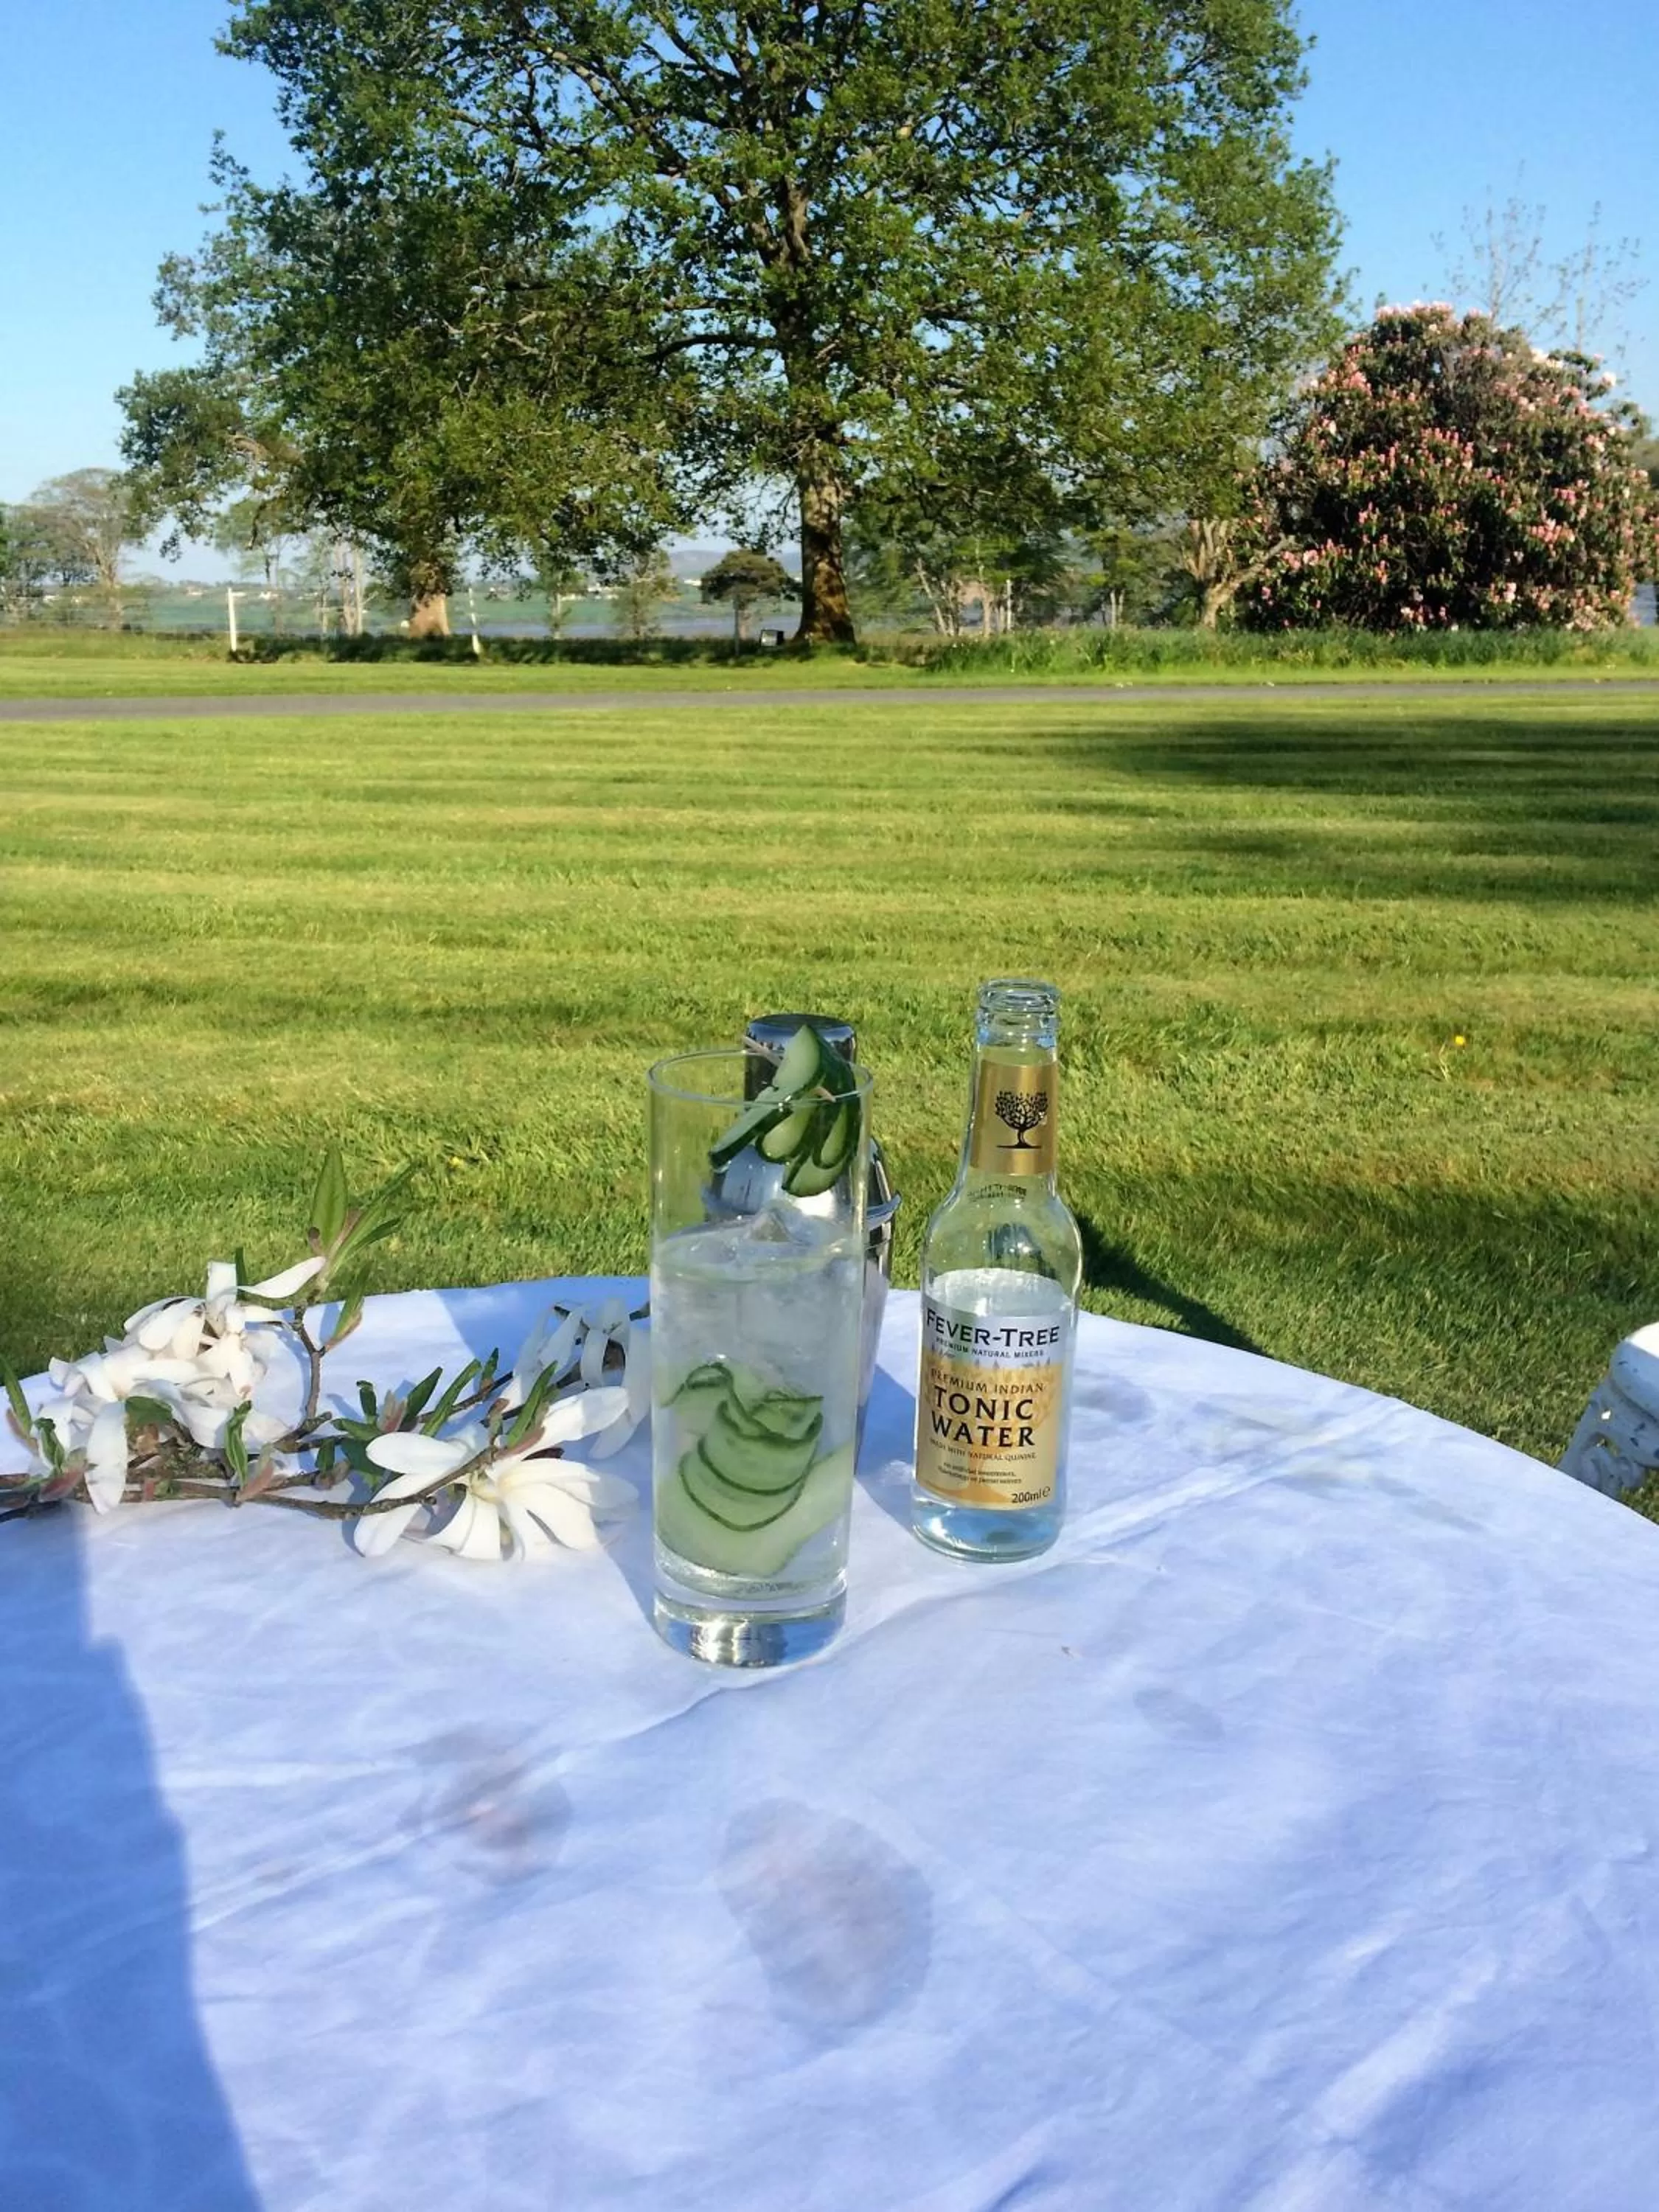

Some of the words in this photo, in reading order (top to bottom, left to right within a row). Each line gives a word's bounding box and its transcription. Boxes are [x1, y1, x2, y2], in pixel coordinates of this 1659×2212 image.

[927, 1308, 1060, 1347] FEVER-TREE
[972, 1348, 1011, 1358] NATURAL
[931, 1368, 987, 1393] PREMIUM
[995, 1382, 1044, 1394] INDIAN
[934, 1385, 1033, 1421] TONIC
[931, 1410, 1035, 1447] WATER
